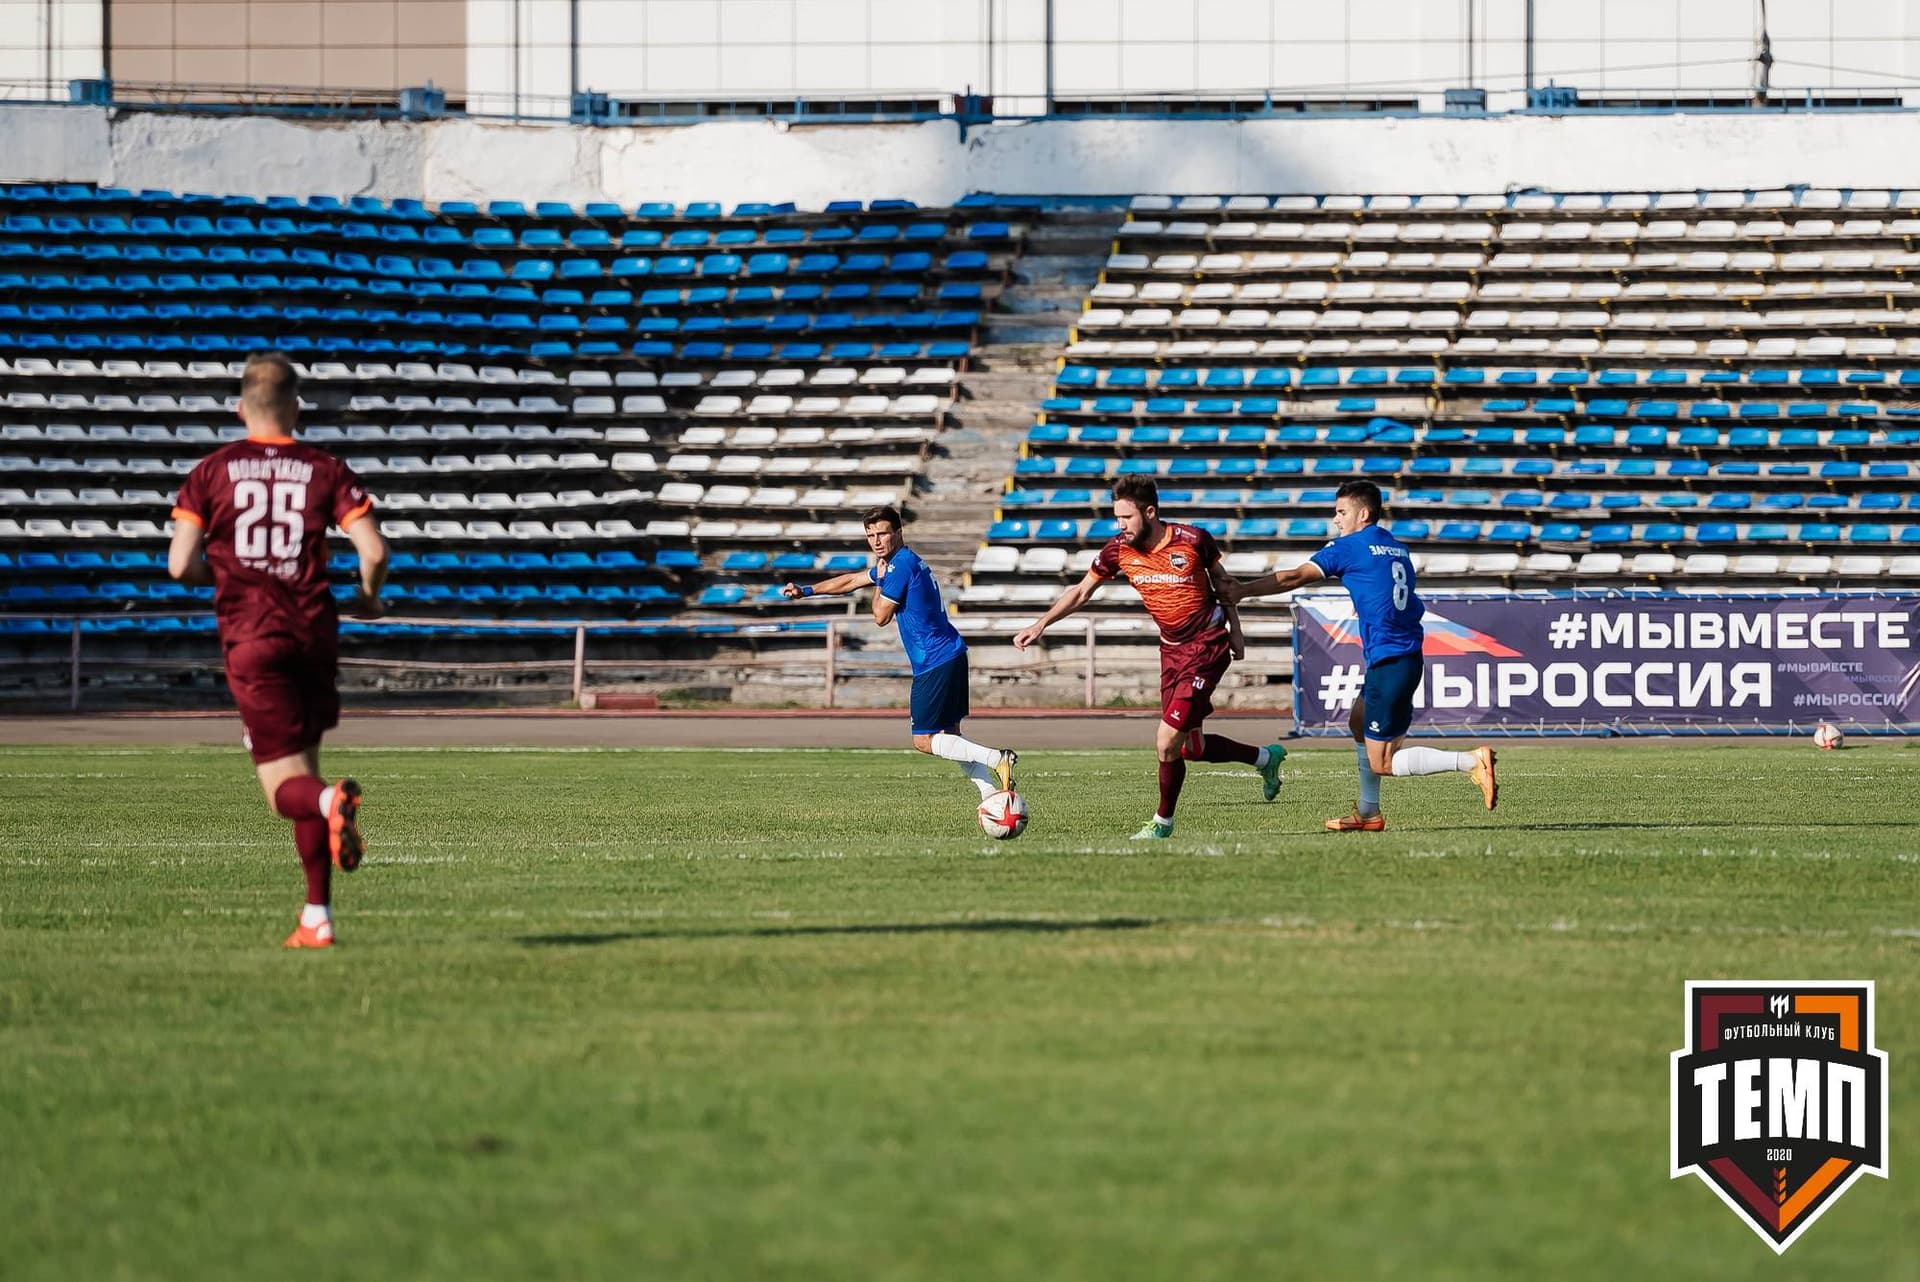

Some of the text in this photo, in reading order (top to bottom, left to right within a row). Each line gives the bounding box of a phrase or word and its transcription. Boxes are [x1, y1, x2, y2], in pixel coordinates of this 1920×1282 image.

[234, 480, 306, 558] 25
[1391, 561, 1409, 611] 8
[1548, 612, 1910, 649] #МЫВМЕСТЕ
[1777, 662, 1864, 673] #МЫВМЕСТЕ
